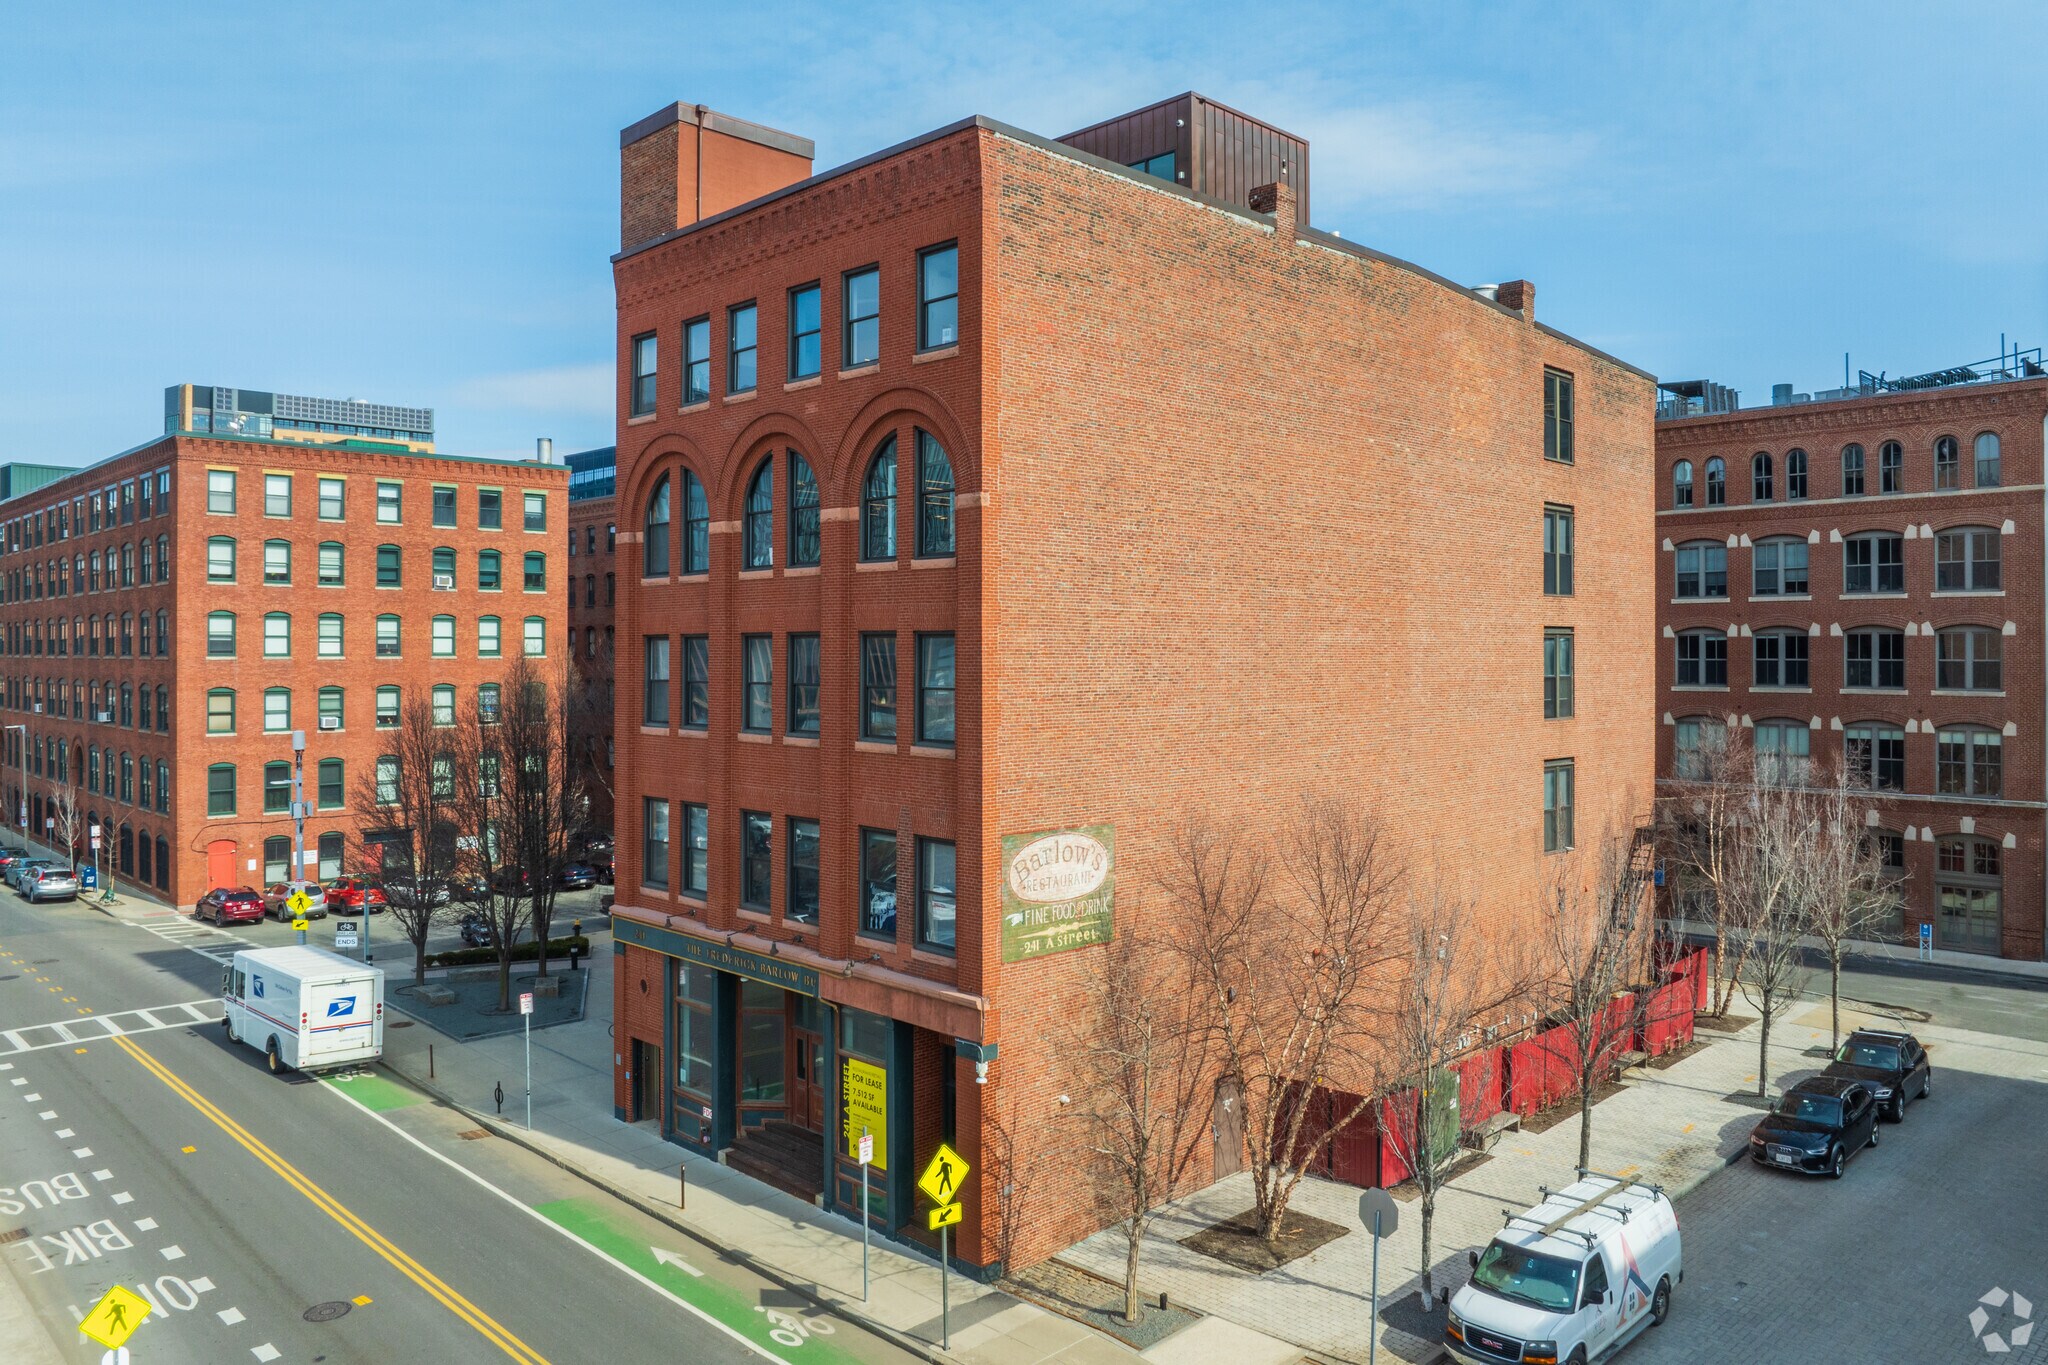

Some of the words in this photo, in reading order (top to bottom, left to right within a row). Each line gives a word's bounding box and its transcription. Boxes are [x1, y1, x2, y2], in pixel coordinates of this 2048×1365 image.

[1013, 839, 1103, 883] Barlow's
[1026, 870, 1092, 893] RESTAURANT
[1025, 906, 1050, 926] FINE
[1052, 902, 1075, 922] FOOD
[1081, 896, 1110, 917] DRINK
[1046, 938, 1054, 949] A
[687, 943, 702, 956] THE
[706, 947, 756, 972] FREDERICK
[760, 962, 799, 983] BARLOW
[852, 1073, 864, 1084] FOR
[865, 1077, 882, 1090] LEASE
[852, 1099, 883, 1116] AVAILABLE
[868, 1093, 875, 1102] SF
[0, 1172, 91, 1215] BUS
[8, 1219, 135, 1275] BIKE
